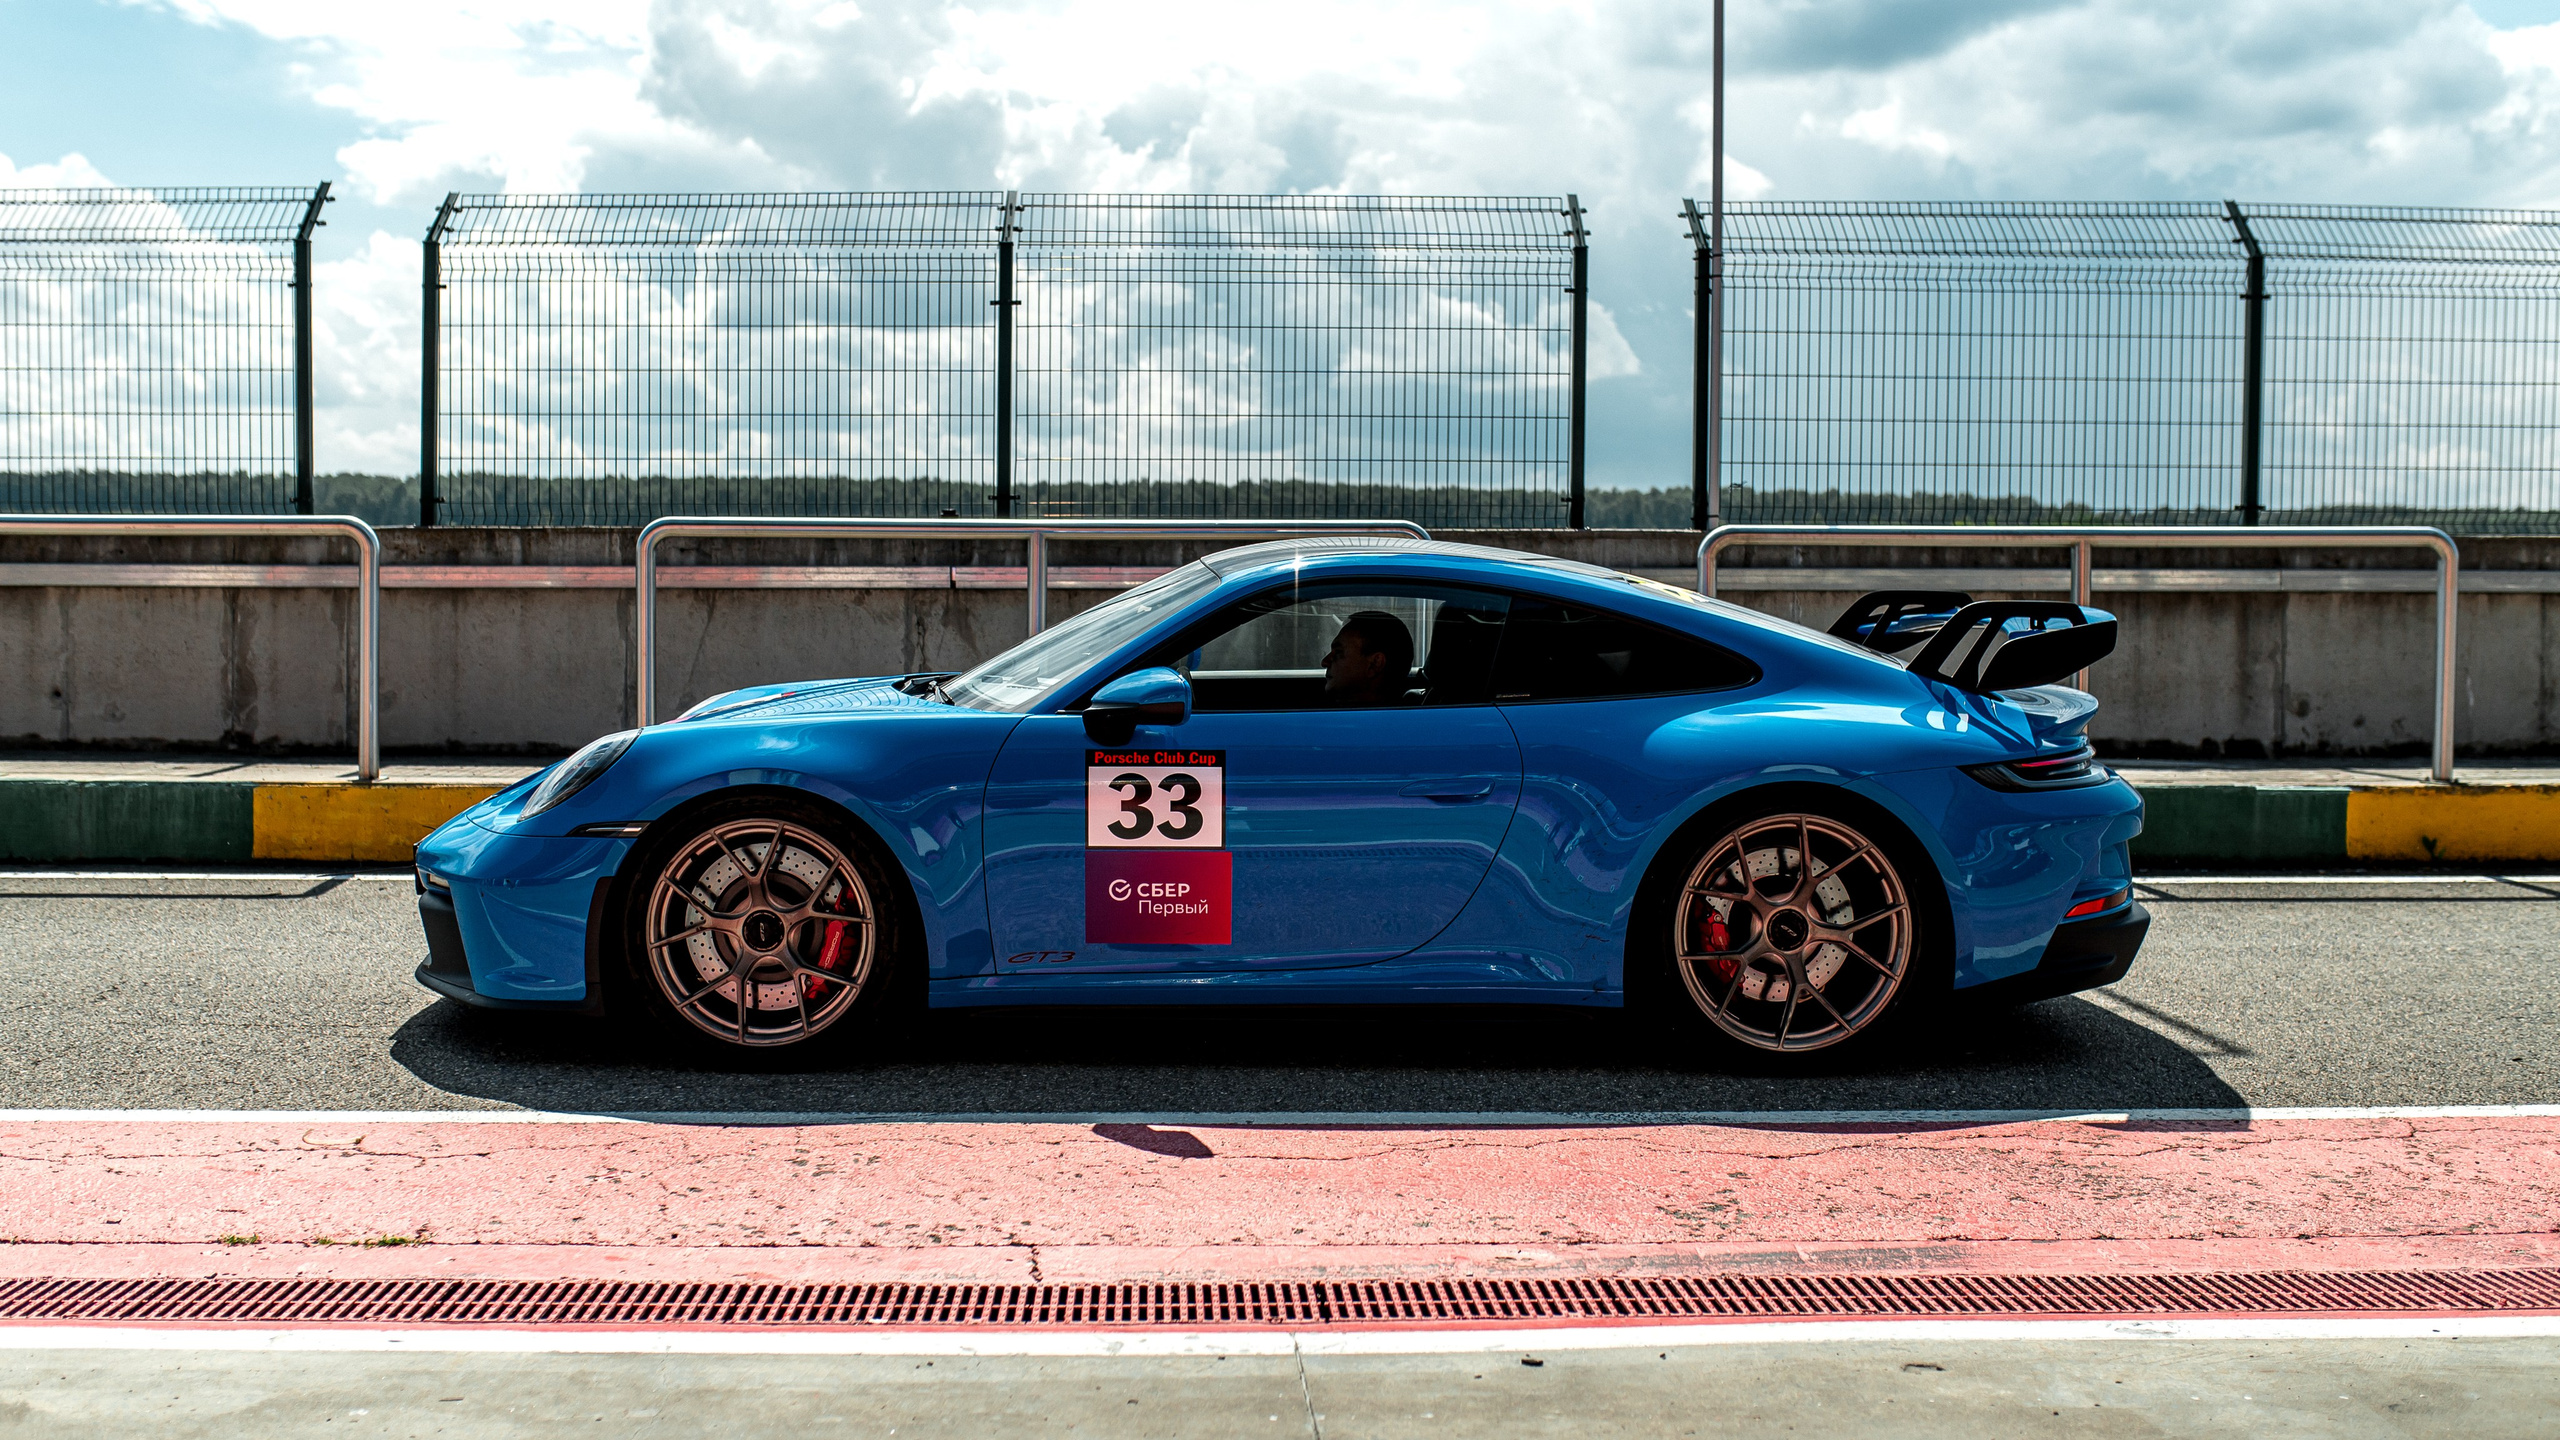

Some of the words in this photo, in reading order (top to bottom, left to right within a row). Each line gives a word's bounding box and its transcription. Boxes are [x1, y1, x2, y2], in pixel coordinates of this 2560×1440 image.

[1094, 751, 1150, 764] Porsche
[1154, 751, 1185, 764] Club
[1189, 751, 1216, 766] Cup
[1107, 772, 1204, 840] 33
[1137, 883, 1190, 897] СБЕР
[1138, 899, 1209, 917] Первый
[1007, 950, 1076, 963] GT3
